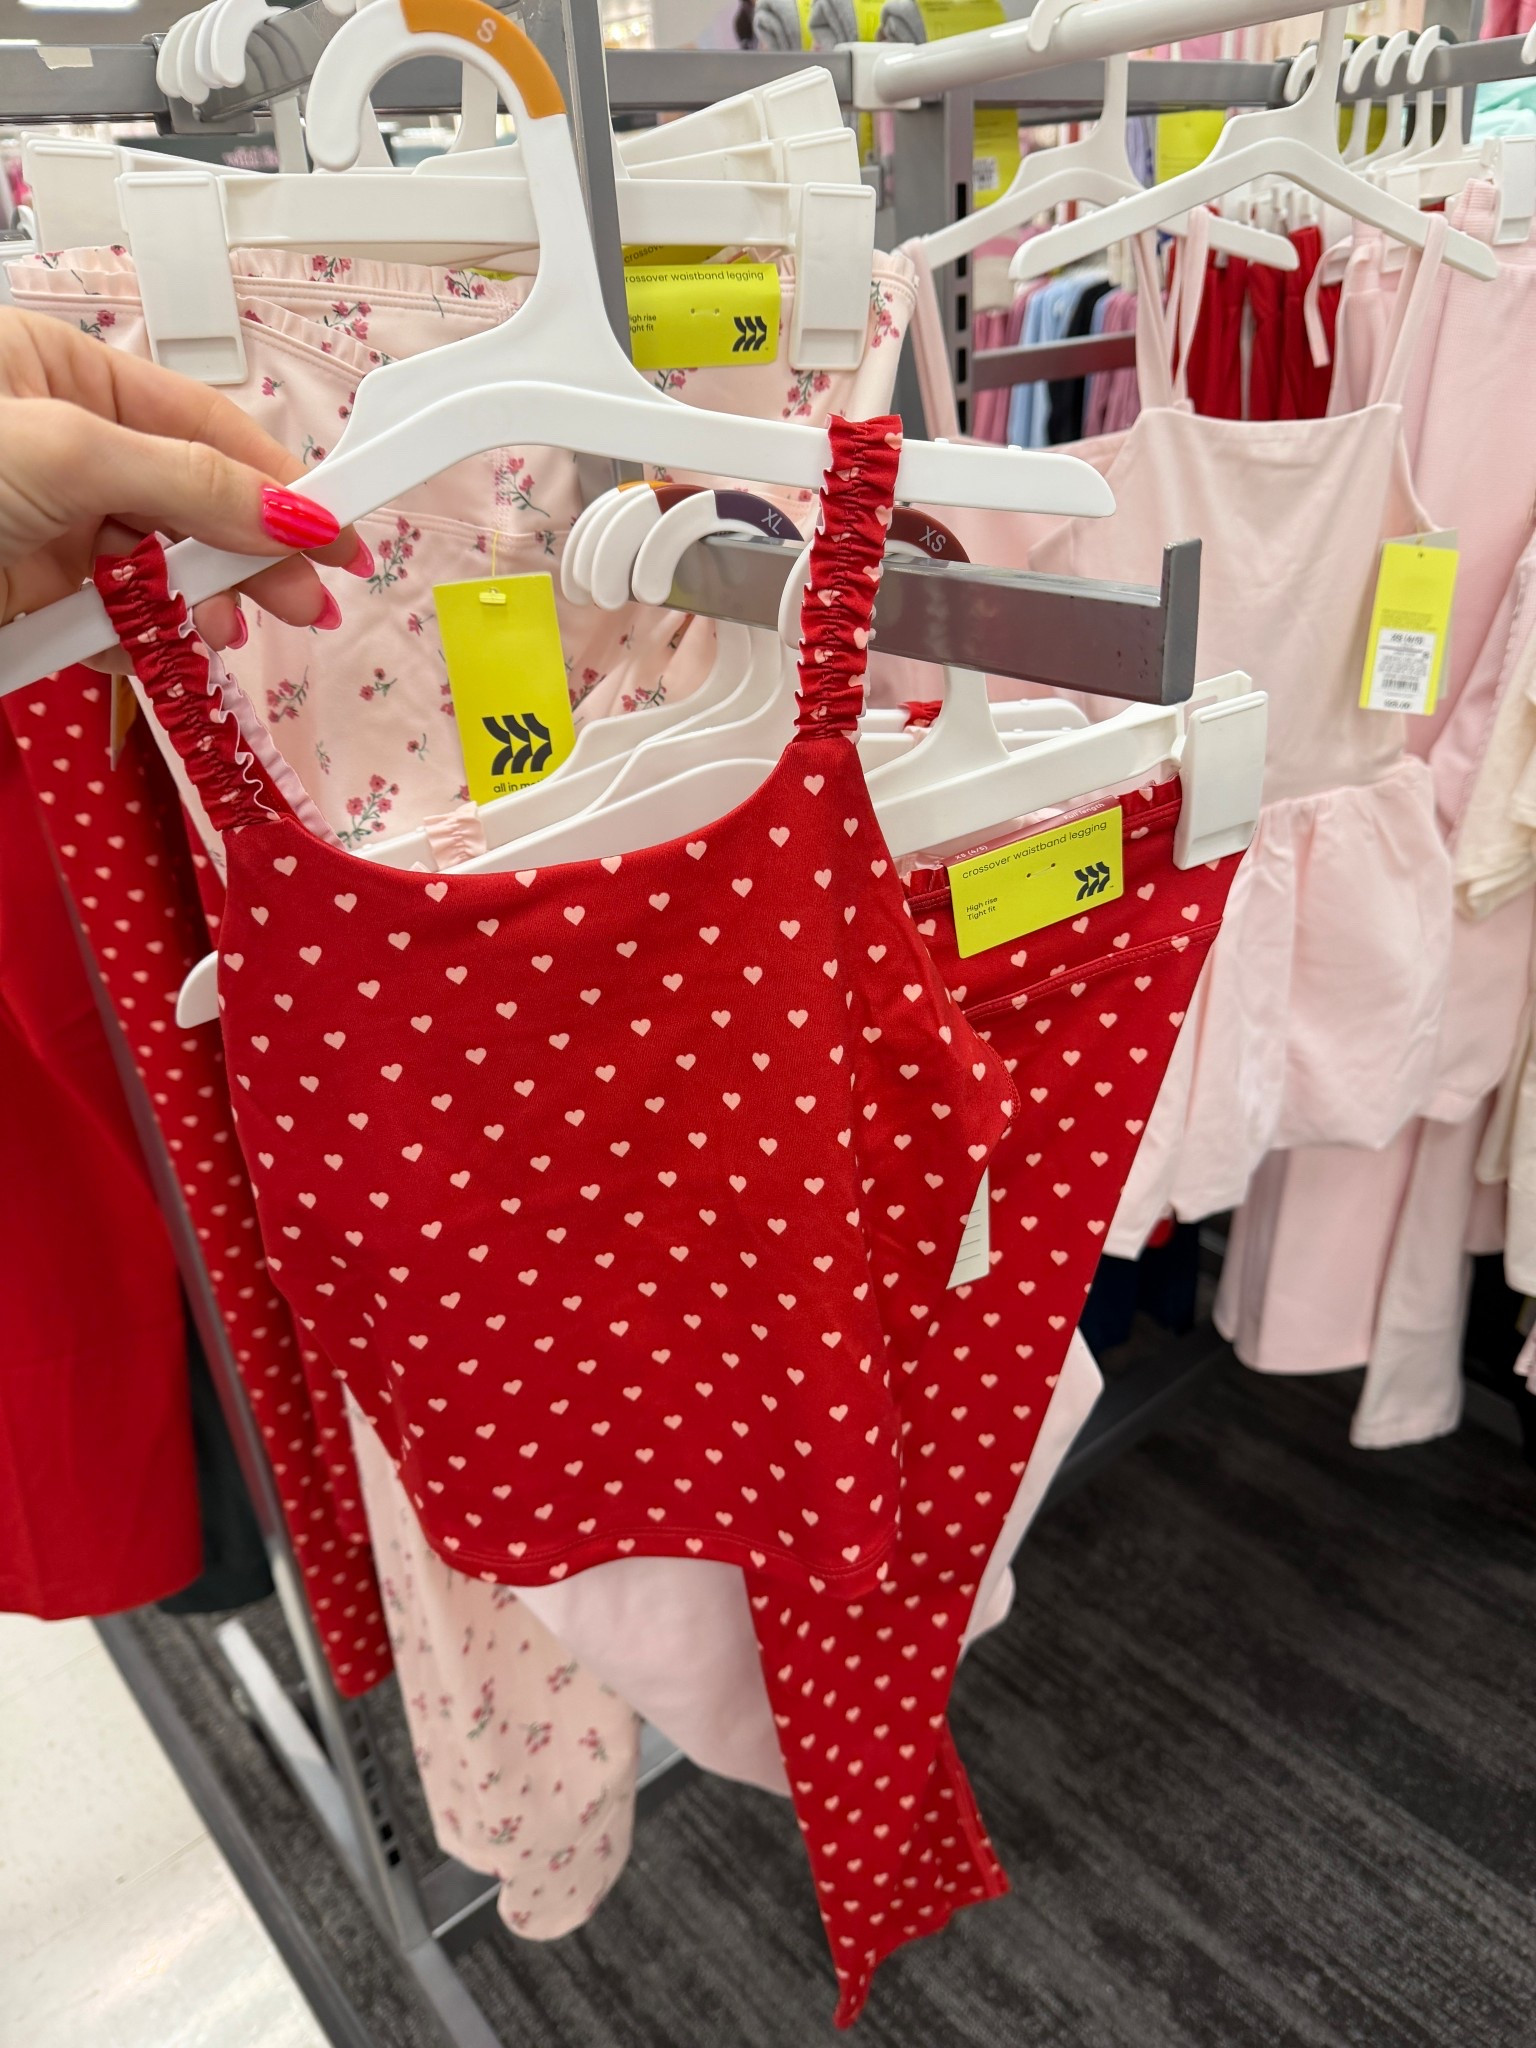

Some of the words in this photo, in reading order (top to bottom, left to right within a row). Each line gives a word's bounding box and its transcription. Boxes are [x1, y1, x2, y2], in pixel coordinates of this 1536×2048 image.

[477, 18, 497, 43] S
[625, 273, 668, 283] rossover
[671, 271, 725, 281] waistband
[727, 270, 764, 281] legging
[643, 313, 657, 321] rise
[629, 324, 644, 333] ight
[645, 323, 654, 331] fit
[761, 508, 784, 535] XL
[918, 525, 947, 552] XS
[493, 782, 506, 793] all
[508, 781, 518, 791] in
[1063, 811, 1078, 820] Full
[1078, 803, 1105, 815] length
[962, 854, 1011, 879] crossover
[1013, 834, 1067, 860] waistband
[1069, 821, 1107, 841] legging
[966, 901, 984, 913] High
[984, 897, 998, 906] rise
[967, 909, 987, 921] Tight
[988, 905, 996, 914] fit
